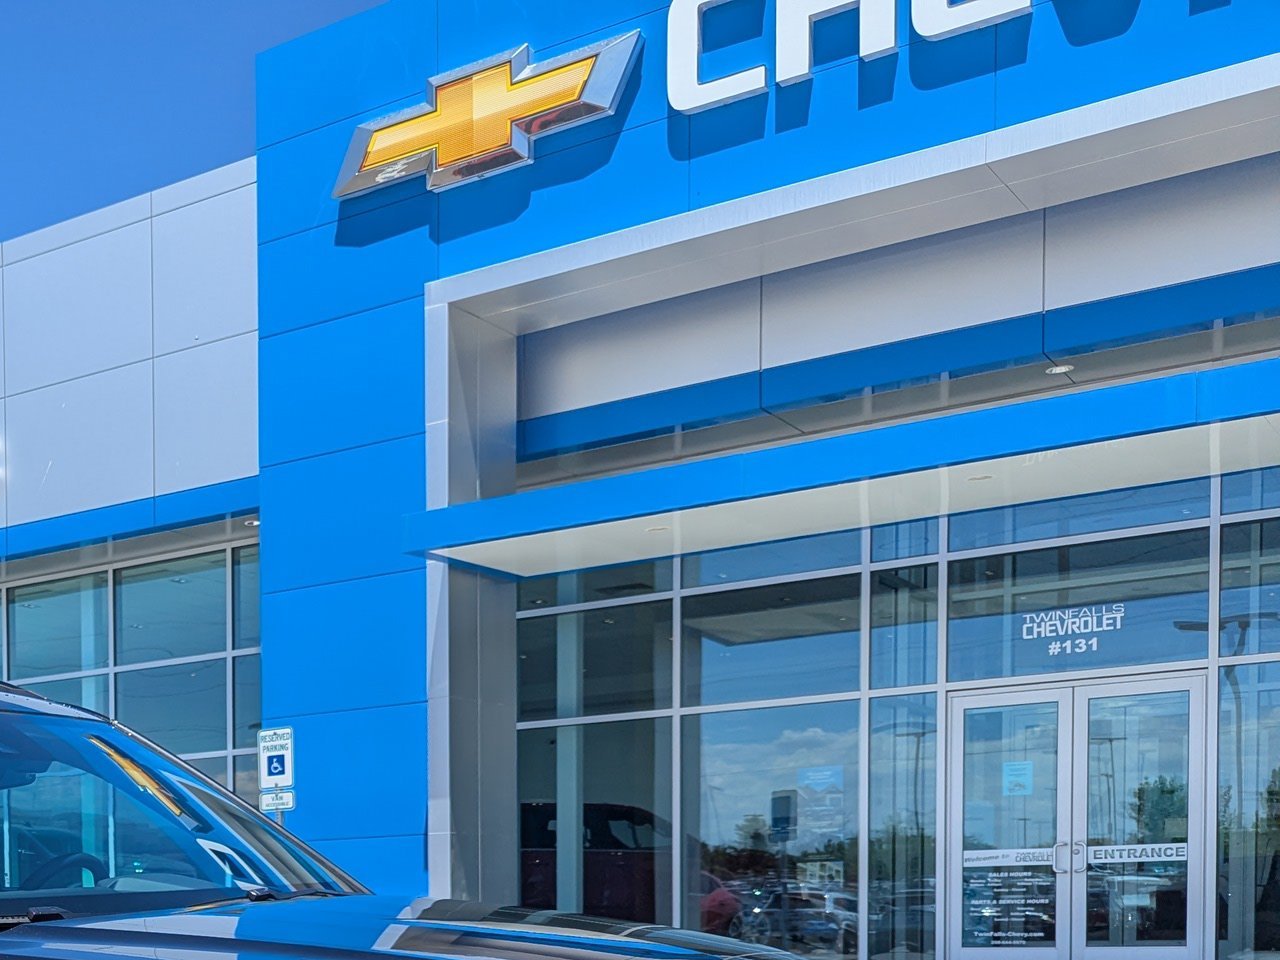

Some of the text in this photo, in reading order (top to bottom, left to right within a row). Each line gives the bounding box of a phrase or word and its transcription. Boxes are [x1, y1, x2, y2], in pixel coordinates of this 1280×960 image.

[1023, 603, 1125, 624] TWINFALLS
[1022, 613, 1125, 640] CHEVROLET
[1048, 637, 1098, 656] #131
[260, 732, 290, 743] RESERVED
[262, 743, 289, 753] PARKING
[1093, 846, 1186, 860] ENTRANCE
